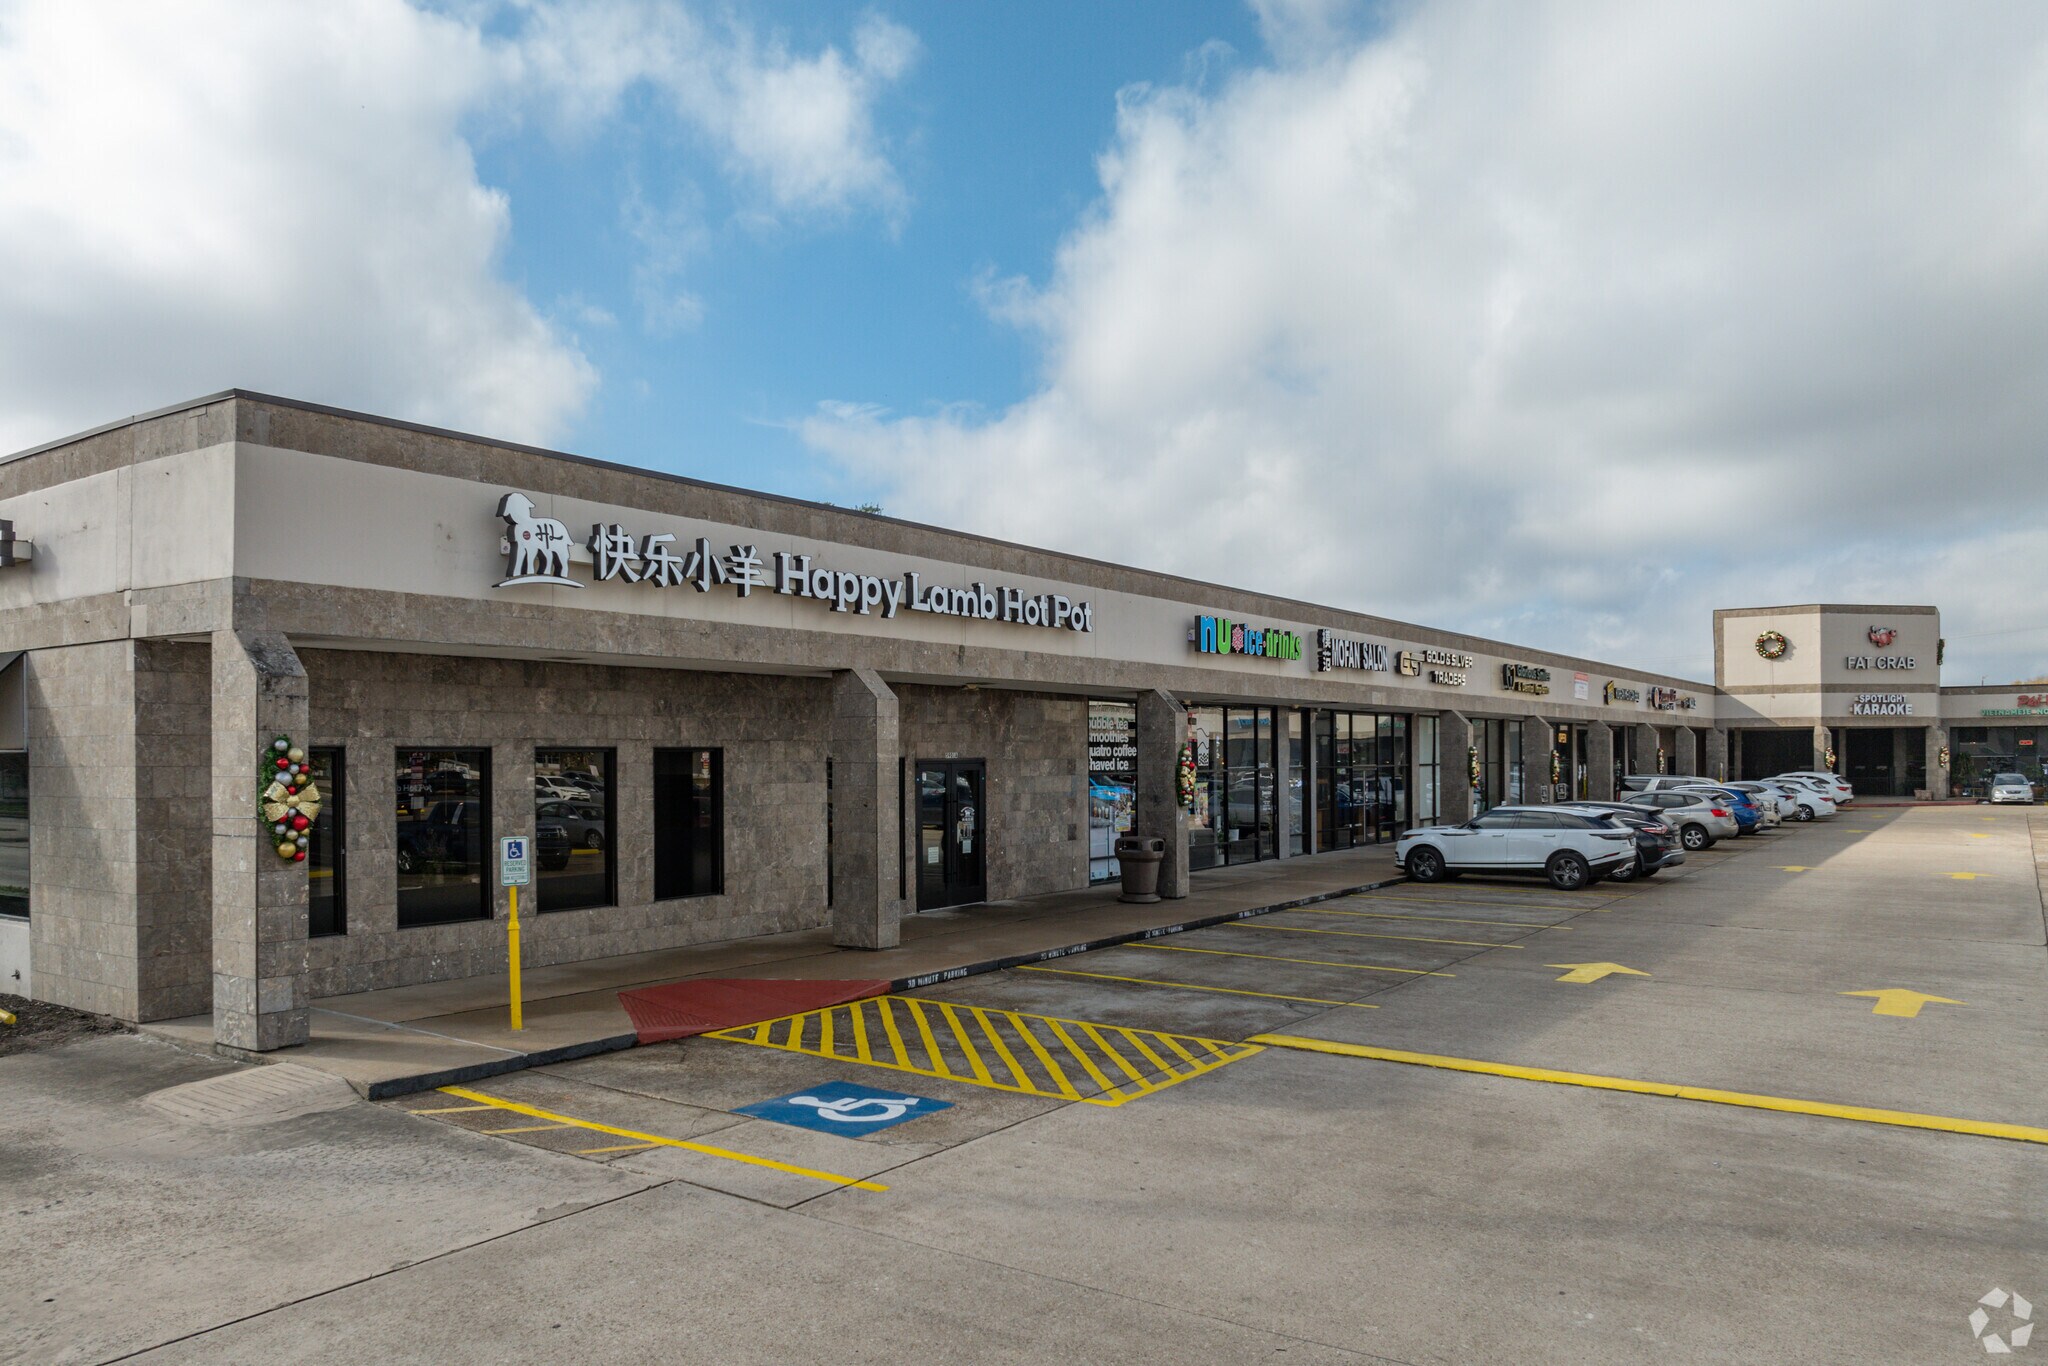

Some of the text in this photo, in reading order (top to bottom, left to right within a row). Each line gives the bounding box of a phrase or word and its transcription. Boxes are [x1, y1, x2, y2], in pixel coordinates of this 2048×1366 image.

[590, 523, 767, 598] 快乐小羊
[778, 552, 1094, 633] Happy Lamb Hot Pot
[1200, 615, 1232, 655] nu
[1331, 639, 1389, 672] MOFAN SALON
[1847, 656, 1916, 669] FAT CRAB
[1434, 670, 1467, 686] TRADERS
[1859, 694, 1907, 703] SPOTLIGHT
[1853, 703, 1913, 715] KARAOKE
[1981, 708, 2032, 716] VIETNAMESE
[1116, 718, 1129, 730] tea
[1113, 744, 1137, 757] coffee
[1089, 757, 1129, 771] haved ice
[917, 974, 939, 986] MINUTE
[943, 968, 968, 980] PARKING
